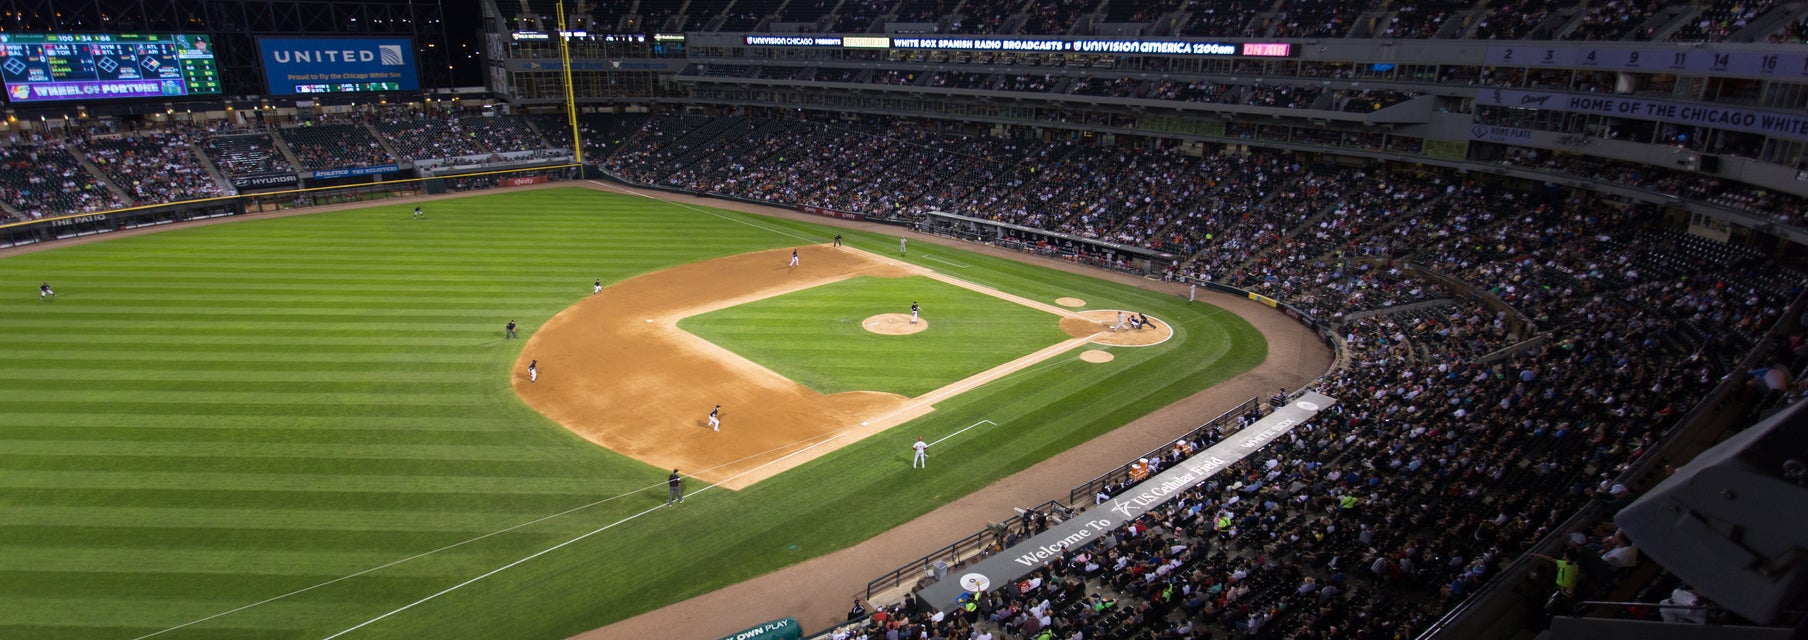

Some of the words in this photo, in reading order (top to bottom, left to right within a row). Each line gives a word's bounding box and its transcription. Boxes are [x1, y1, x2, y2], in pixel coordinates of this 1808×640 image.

[786, 38, 814, 46] CHICAGO
[893, 38, 919, 48] WHITE
[920, 38, 937, 48] SOX
[938, 39, 973, 49] SPANISH
[974, 39, 1001, 50] RADIO
[1002, 40, 1063, 50] BROADCASTS
[274, 50, 375, 63] UNITED
[1504, 48, 1513, 59] 2
[1545, 49, 1554, 60] 3
[1587, 50, 1596, 61] 4
[1629, 51, 1640, 63] 9
[1674, 52, 1687, 65] 11
[1713, 53, 1730, 67] 14
[1761, 55, 1778, 69] 16
[319, 73, 329, 81] fly
[33, 84, 84, 96] WHEEL
[83, 84, 100, 95] OF
[102, 83, 160, 95] FORTUNE
[1569, 97, 1613, 111] HOME
[1618, 101, 1641, 114] OF
[1647, 103, 1677, 118] THE
[1680, 107, 1756, 127] CHICAGO
[1761, 115, 1808, 135] WHITE
[1490, 127, 1509, 137] HOME
[1510, 128, 1532, 139] PLATE
[252, 175, 297, 185] HYUNDAI
[514, 177, 534, 186] xfinity
[51, 218, 73, 227] THE
[75, 214, 106, 224] PATIO
[1240, 429, 1277, 448] WHITE
[1151, 471, 1197, 497] Cellular
[1190, 456, 1225, 476] Field
[1015, 529, 1092, 567] Welcome
[1085, 519, 1111, 531] To
[736, 627, 764, 640] OWN
[764, 619, 789, 632] PLAY
